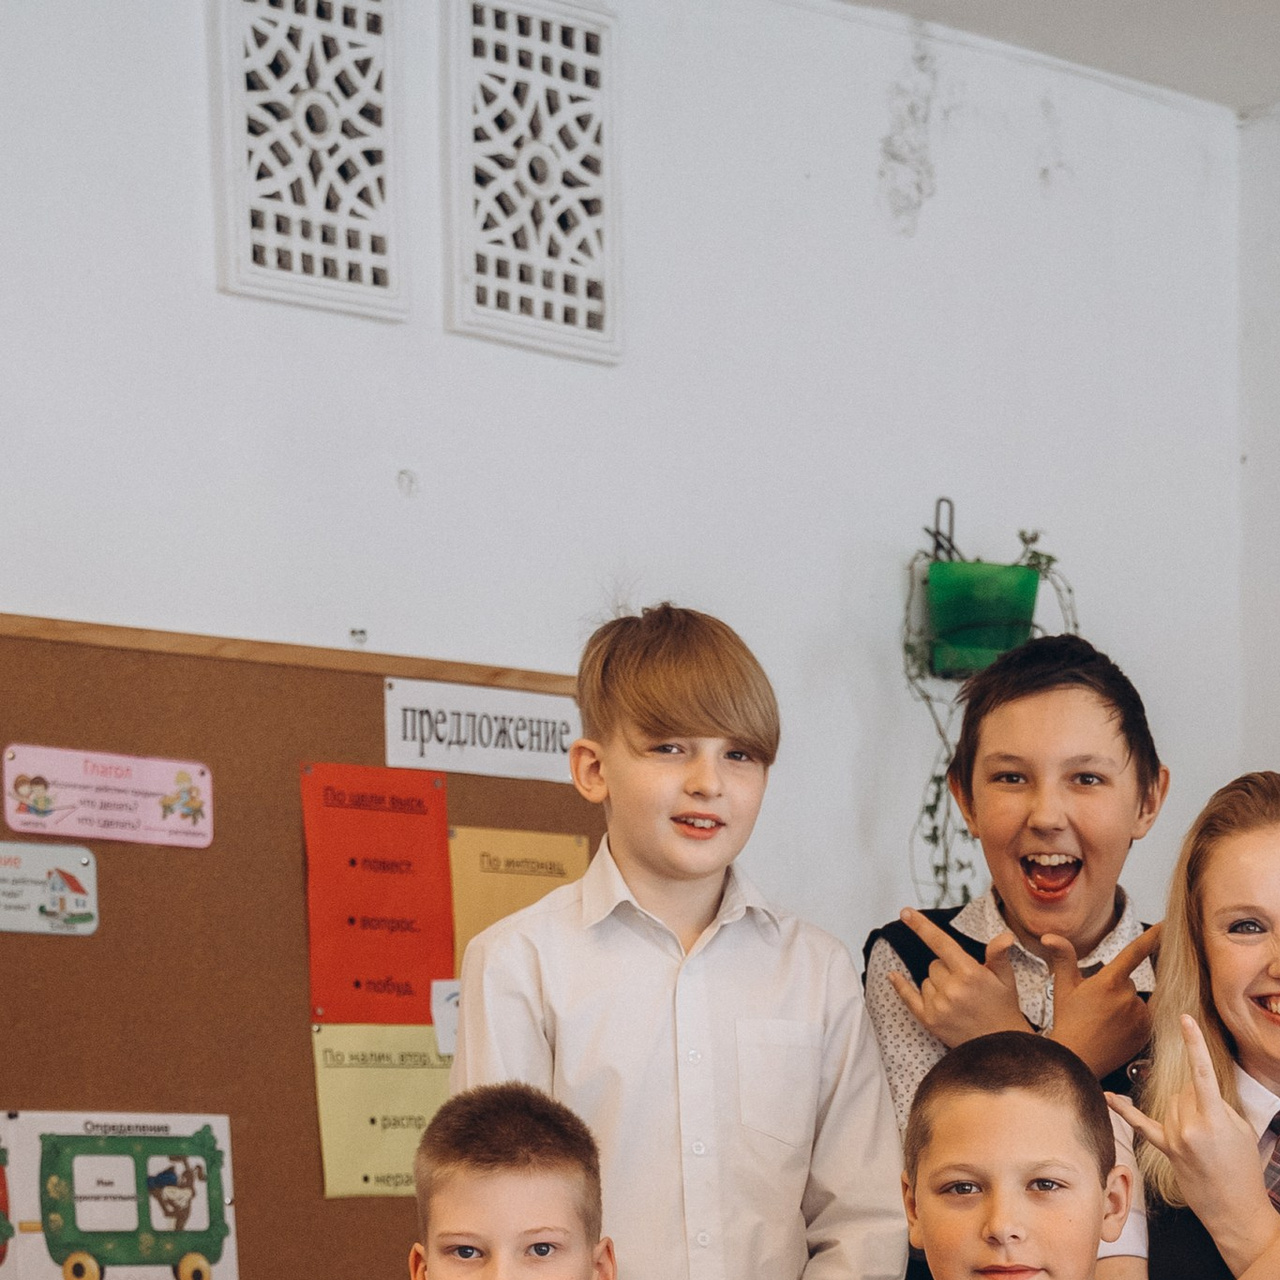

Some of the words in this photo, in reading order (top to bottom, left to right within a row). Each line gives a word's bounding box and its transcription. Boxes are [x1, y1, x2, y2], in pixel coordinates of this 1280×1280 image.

[401, 706, 571, 758] предложение
[82, 759, 133, 779] Глагол
[323, 785, 346, 806] По
[480, 851, 501, 871] По
[322, 1048, 346, 1065] По
[84, 1121, 170, 1136] Определение
